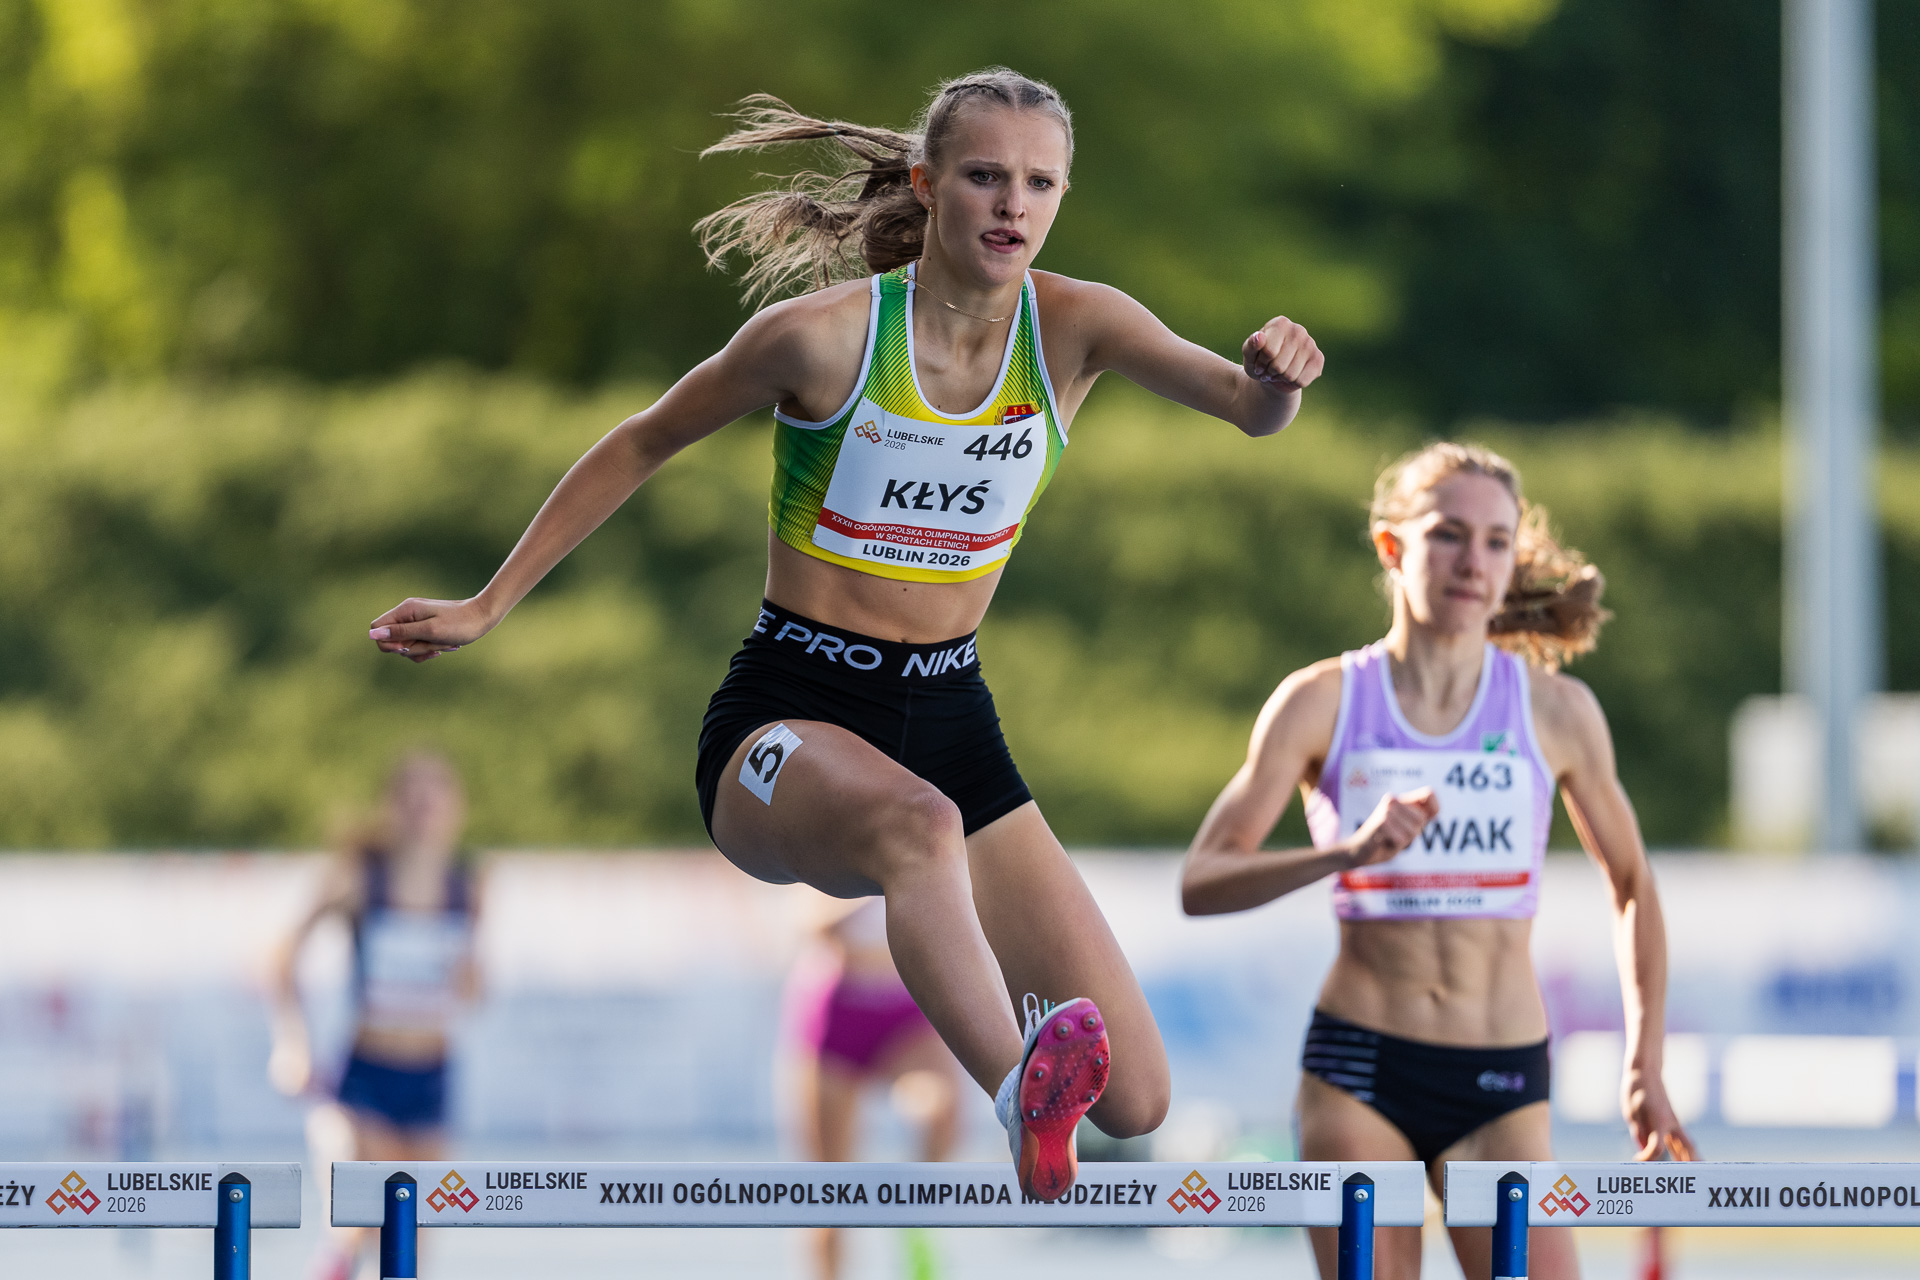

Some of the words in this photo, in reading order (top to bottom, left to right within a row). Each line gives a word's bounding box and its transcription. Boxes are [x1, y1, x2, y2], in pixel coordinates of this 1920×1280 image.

[883, 439, 907, 451] 2026
[886, 428, 945, 446] LUBELSKIE
[963, 427, 1033, 461] 446
[880, 478, 993, 515] KŁYŚ
[831, 514, 853, 528] XXXII
[854, 523, 923, 537] OGÓLNOPOLSKA
[924, 530, 971, 543] OLIMPIADA
[875, 532, 886, 540] W
[886, 533, 933, 547] SPORTACH
[933, 539, 970, 550] LETNICH
[862, 543, 926, 563] LUBLIN
[928, 553, 971, 567] 2026
[774, 620, 883, 671] PRO
[901, 635, 977, 677] NIKE
[748, 740, 784, 784] 5
[1446, 762, 1513, 791] 463
[107, 1172, 213, 1191] LUBELSKIE
[485, 1171, 588, 1190] LUBELSKIE
[1228, 1172, 1331, 1191] LUBELSKIE
[1596, 1176, 1696, 1194] LUBELSKIE
[600, 1182, 664, 1205] XXXII
[673, 1177, 869, 1205] OGÓLNOPOLSKA
[877, 1183, 1013, 1205] OLIMPIADA
[1021, 1179, 1158, 1205] DZIEŻY
[1708, 1186, 1770, 1208] XXXII
[107, 1196, 146, 1213] 2026
[485, 1194, 523, 1211] 2026
[1227, 1196, 1266, 1212] 2026
[1596, 1199, 1634, 1215] 2026
